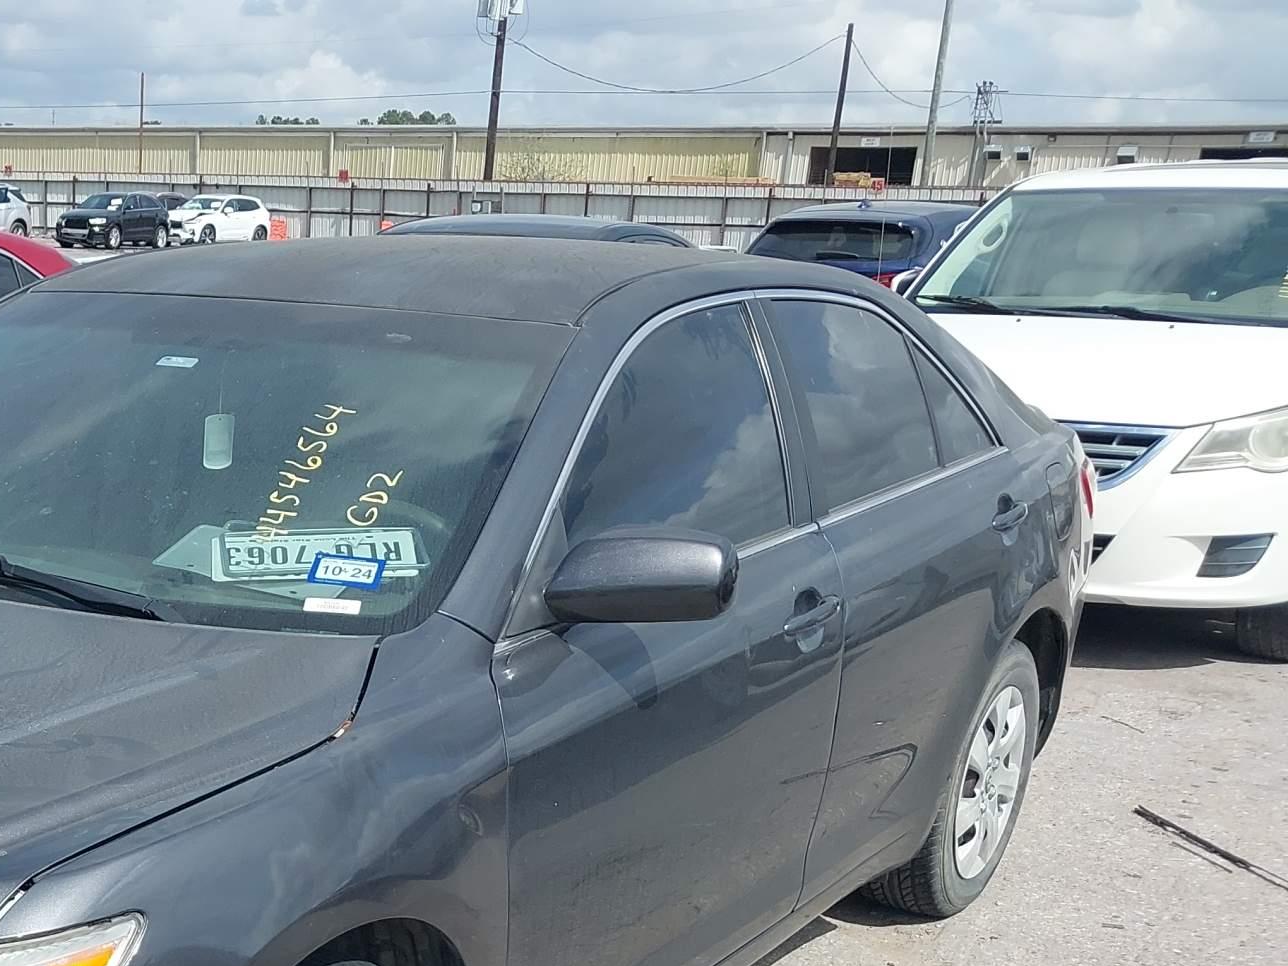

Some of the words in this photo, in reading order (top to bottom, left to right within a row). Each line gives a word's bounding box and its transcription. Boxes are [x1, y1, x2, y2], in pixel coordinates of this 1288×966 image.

[251, 403, 356, 544] 44546564
[346, 470, 404, 527] GD2
[227, 545, 308, 566] 7063
